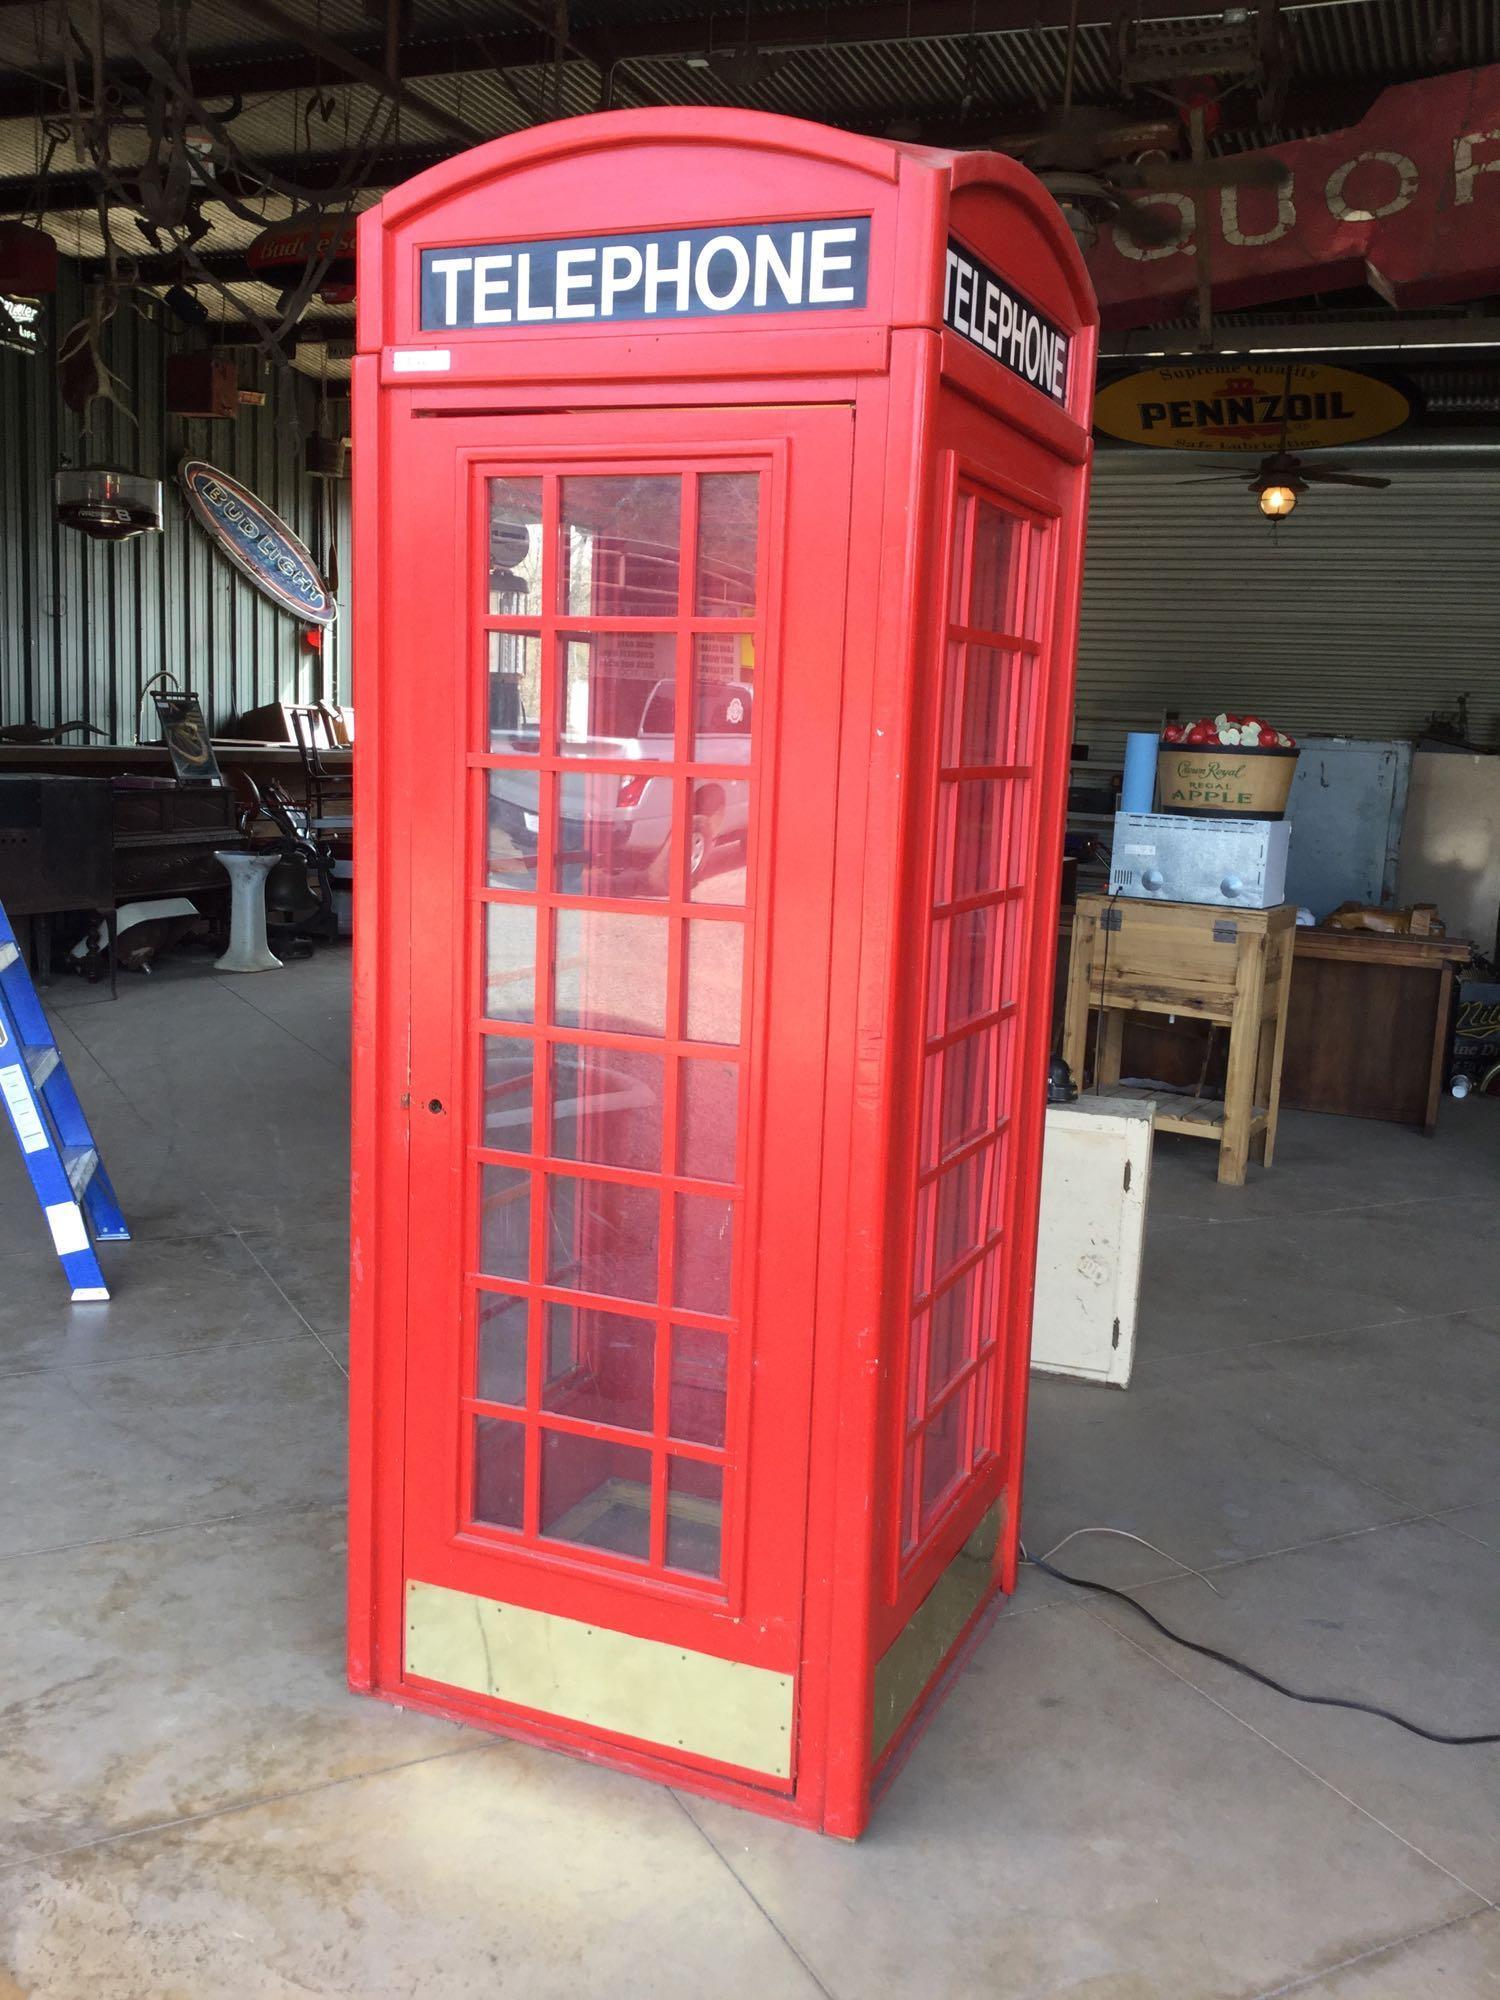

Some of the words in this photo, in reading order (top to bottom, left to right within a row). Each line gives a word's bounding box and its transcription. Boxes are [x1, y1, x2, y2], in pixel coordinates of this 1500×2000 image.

[431, 226, 857, 327] TELEPHONE
[941, 246, 1067, 399] TELEPHONE
[1136, 391, 1356, 430] PENNZOIL
[201, 480, 260, 540] BUD
[257, 536, 325, 602] LIGHT
[1177, 760, 1206, 779] Crown
[1200, 761, 1247, 780] Royal
[1189, 781, 1232, 790] REGAL
[1171, 789, 1254, 804] APPLE
